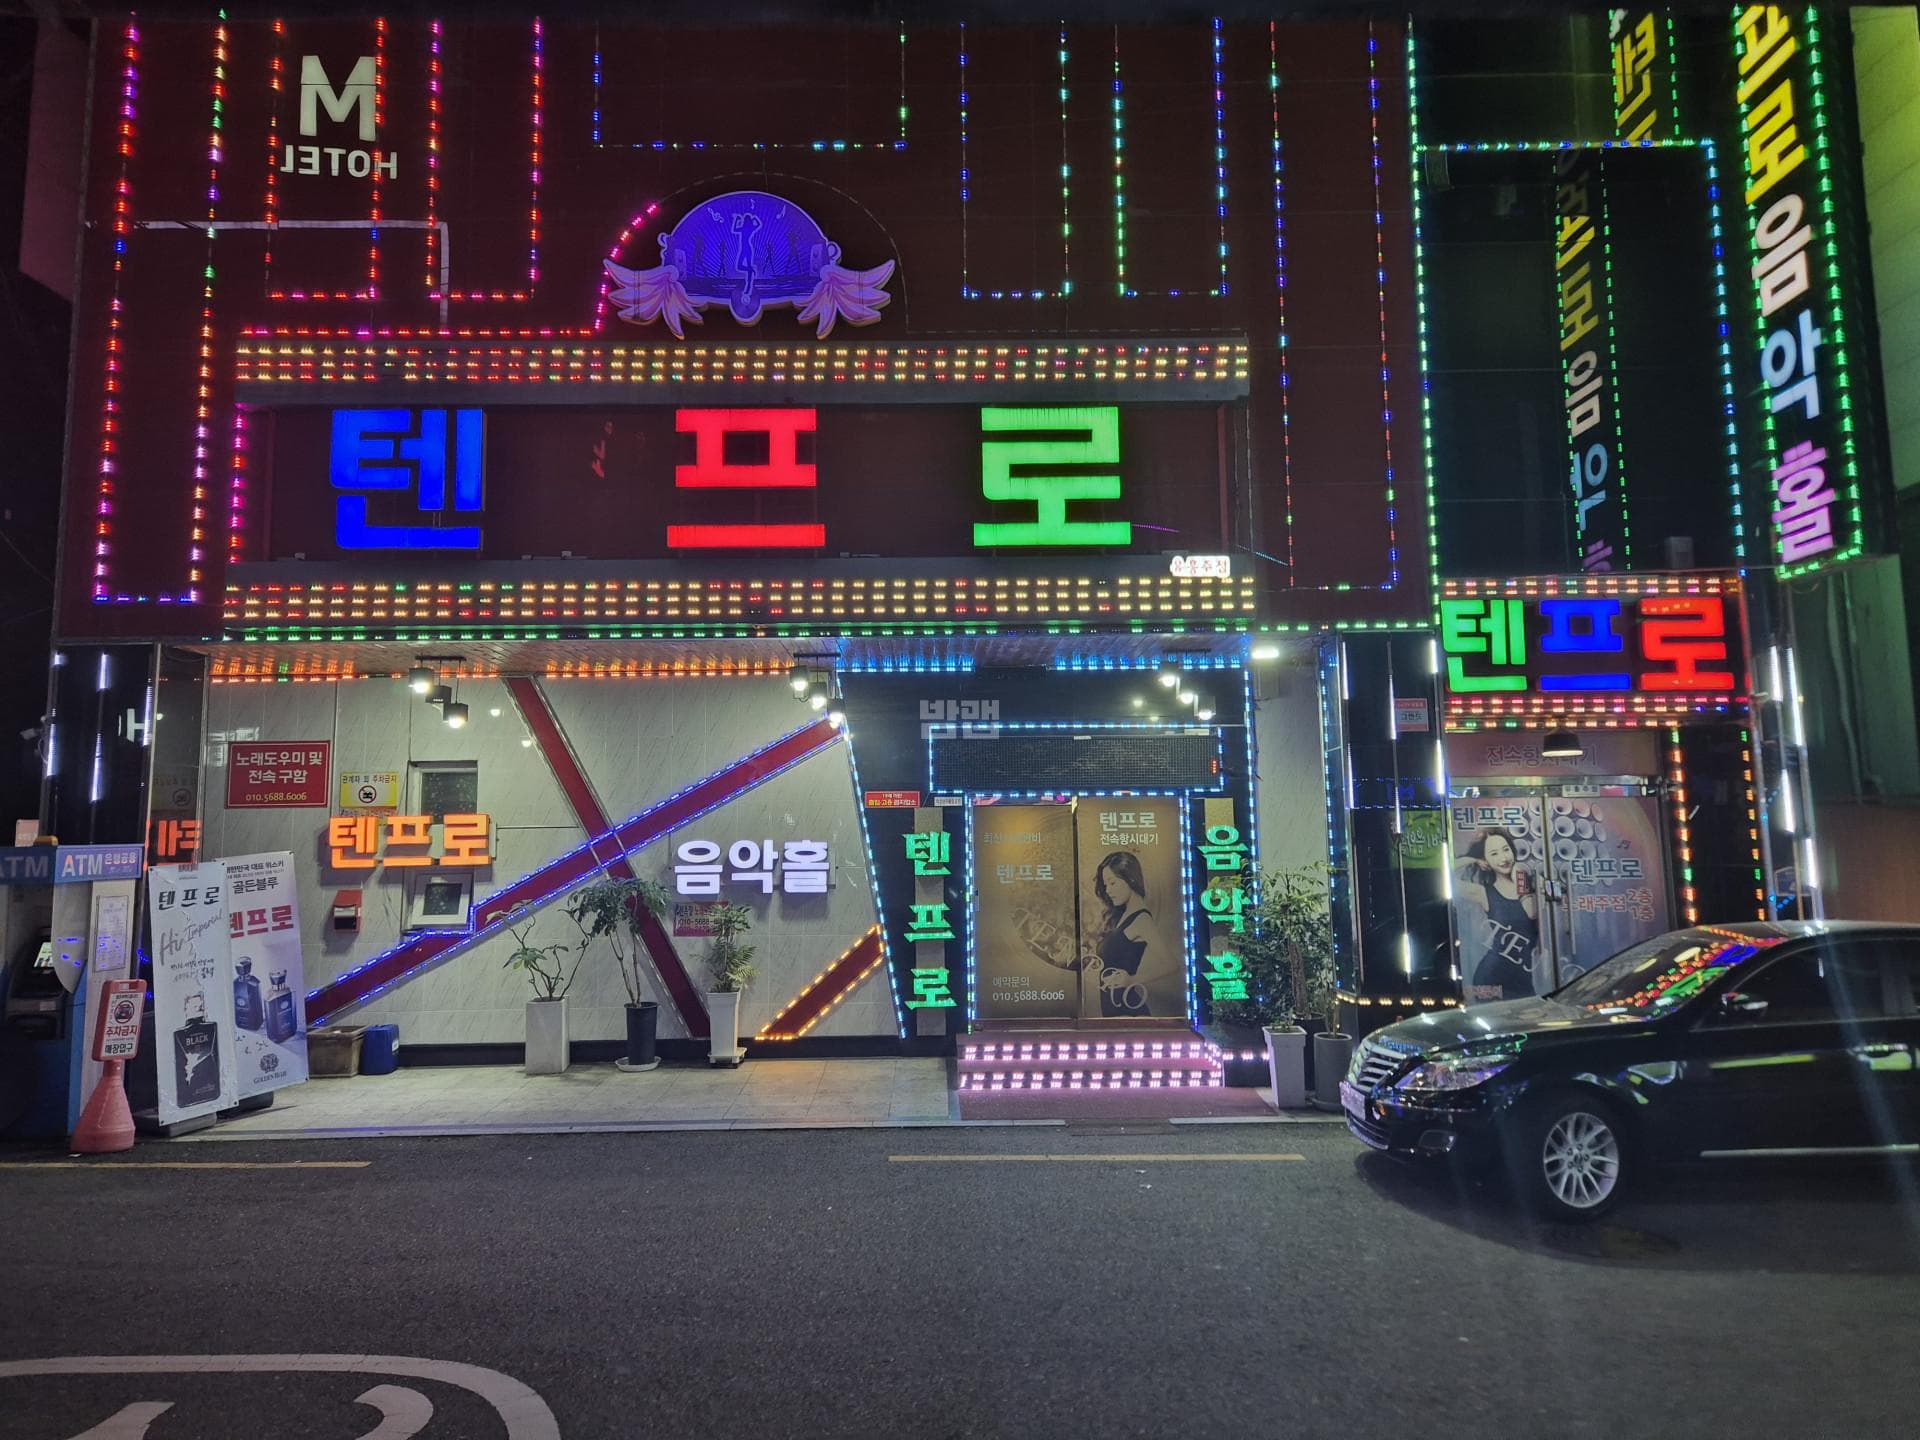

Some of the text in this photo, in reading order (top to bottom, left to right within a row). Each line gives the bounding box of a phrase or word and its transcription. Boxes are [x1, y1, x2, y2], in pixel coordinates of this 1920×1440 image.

[331, 406, 1132, 550] 텐프로
[1441, 597, 1734, 692] 텐프로
[236, 751, 323, 766] 노래도우미 및
[248, 769, 308, 784] 전속 구함
[245, 791, 307, 802] 010.5688.6006
[1099, 811, 1158, 832] 텐프로
[1453, 806, 1526, 830] 텐프로
[328, 813, 492, 868] 텐프로
[1100, 832, 1159, 846] 전속항시대기
[61, 853, 103, 878] ATM
[674, 839, 830, 895] 음악홀
[996, 863, 1054, 884] 텐프로
[1570, 858, 1644, 883] 텐프로
[232, 877, 279, 895] 골든블루
[158, 886, 220, 911] 텐프로
[902, 831, 958, 1010] 텐프로
[1196, 824, 1253, 1001] 음악홀
[992, 990, 1065, 1003] 010.5688.6006
[106, 1024, 138, 1037] 주차금지
[185, 1033, 209, 1046] BLACK
[104, 1043, 133, 1054] 매장입구
